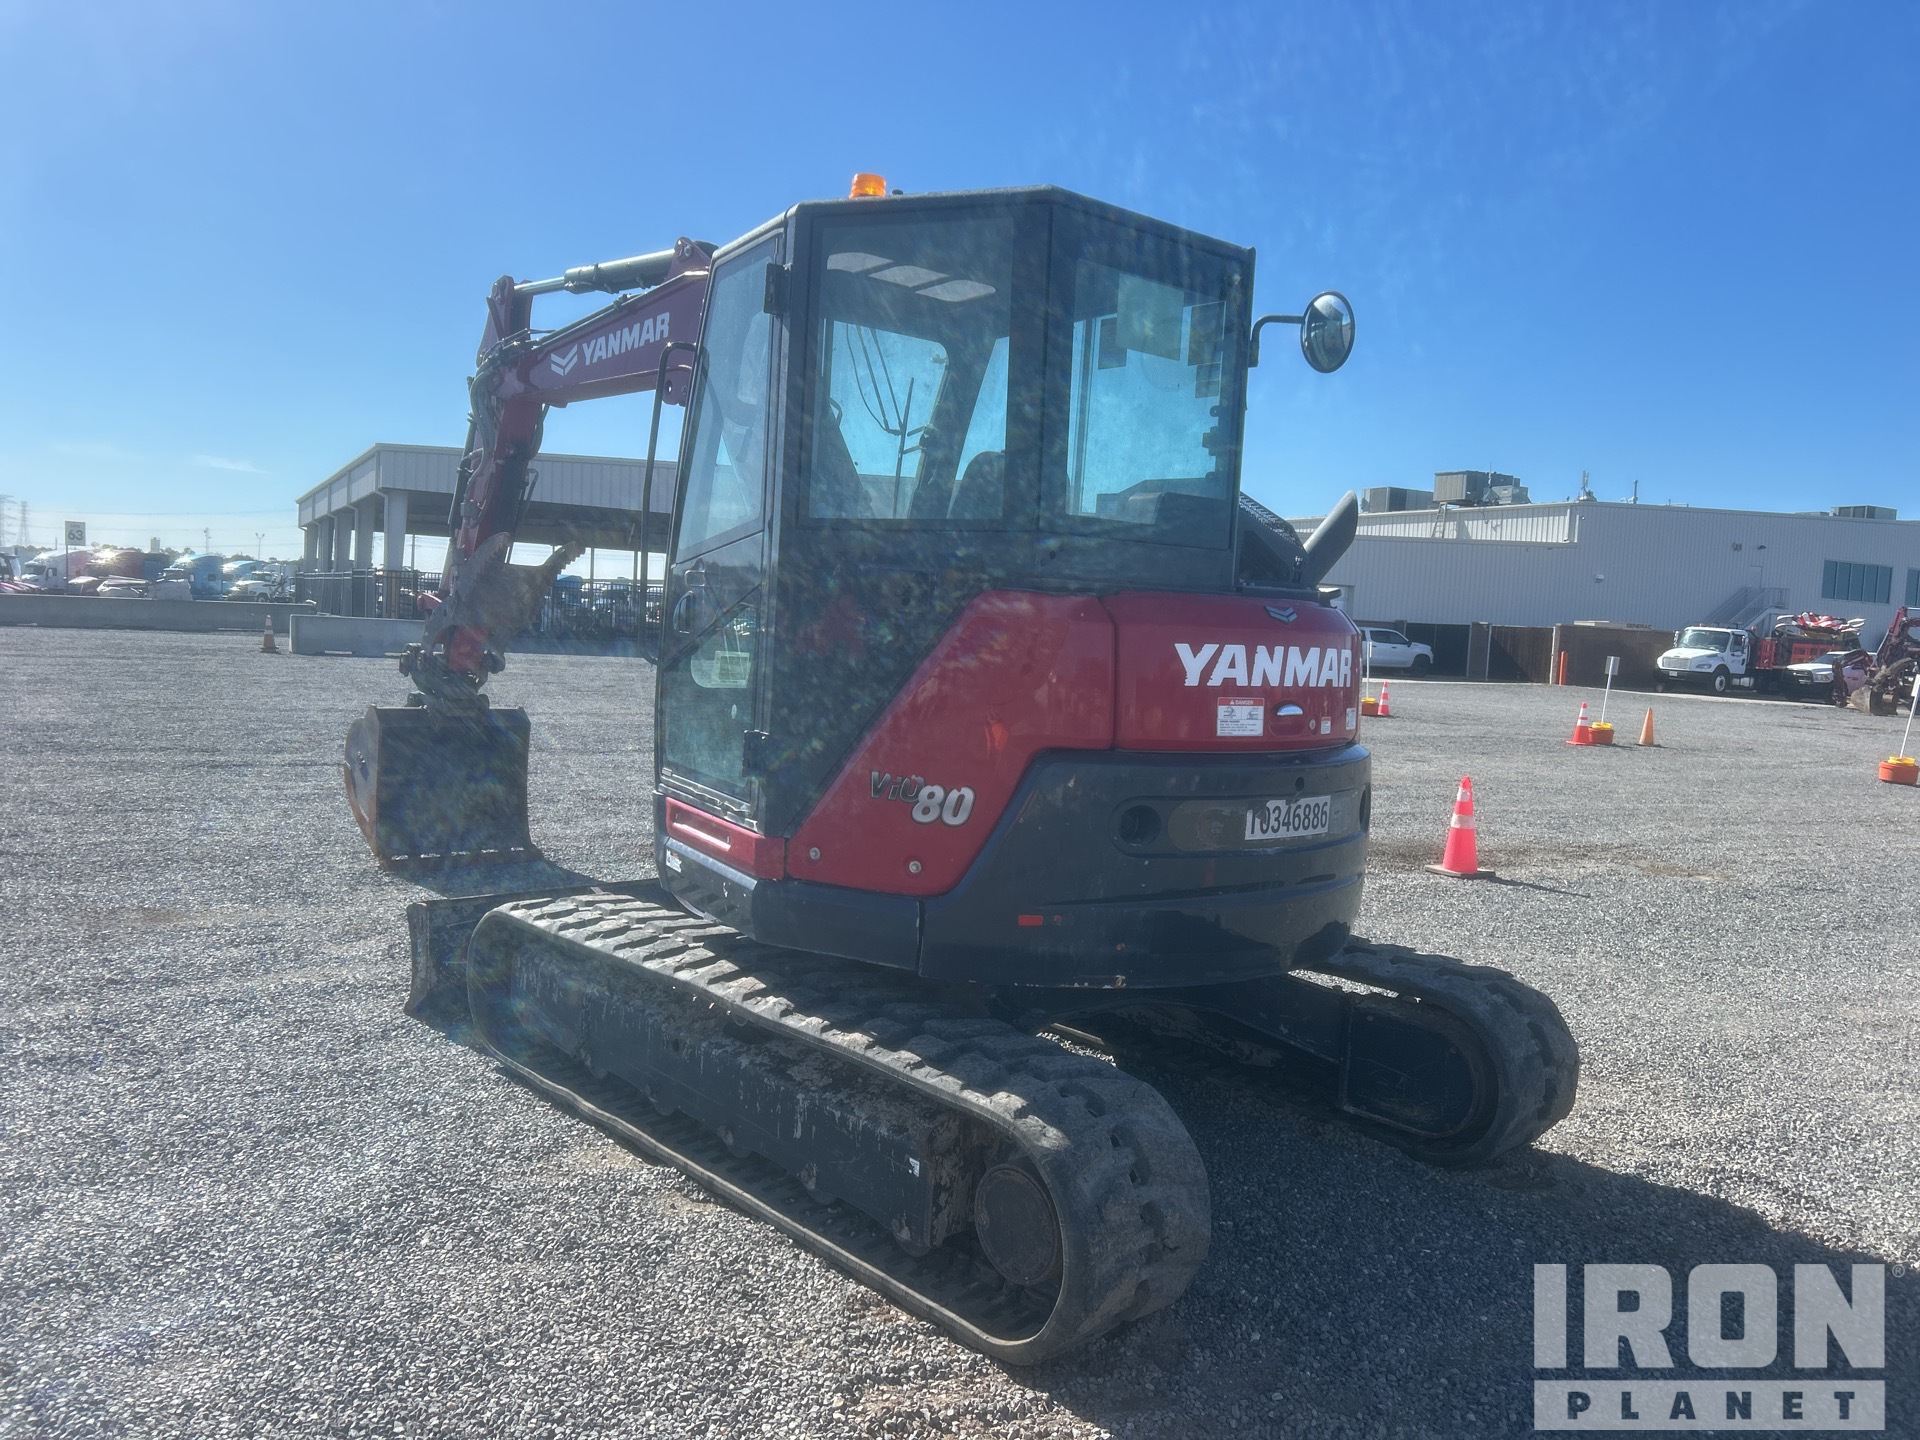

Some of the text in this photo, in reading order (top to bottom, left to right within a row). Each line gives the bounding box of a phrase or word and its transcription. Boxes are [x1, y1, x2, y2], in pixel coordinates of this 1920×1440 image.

[582, 312, 670, 366] YANMAR
[68, 529, 83, 541] 63
[1174, 643, 1352, 688] YANMAR
